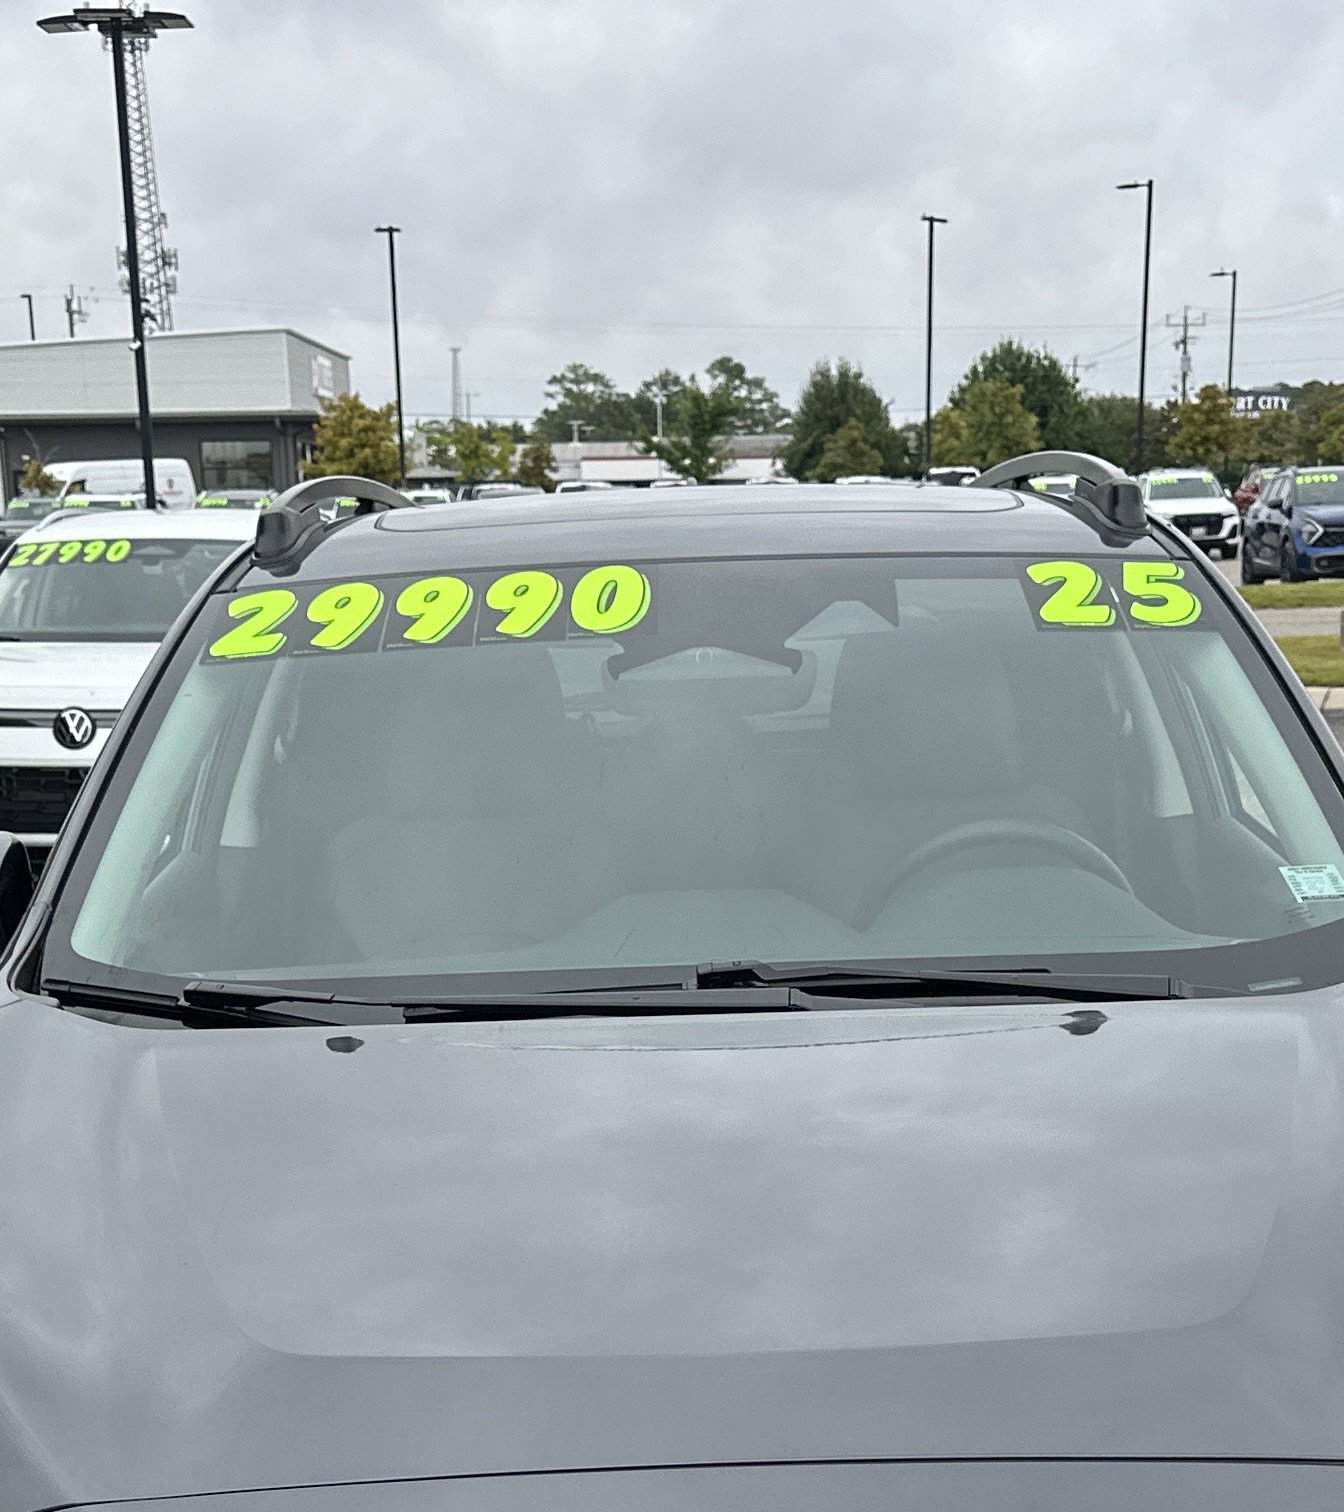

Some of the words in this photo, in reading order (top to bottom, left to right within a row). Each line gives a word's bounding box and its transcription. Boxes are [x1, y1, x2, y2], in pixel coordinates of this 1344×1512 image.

[1258, 396, 1291, 411] CITY
[8, 539, 132, 567] 27990
[209, 565, 651, 659] 29990
[1026, 561, 1202, 627] 25
